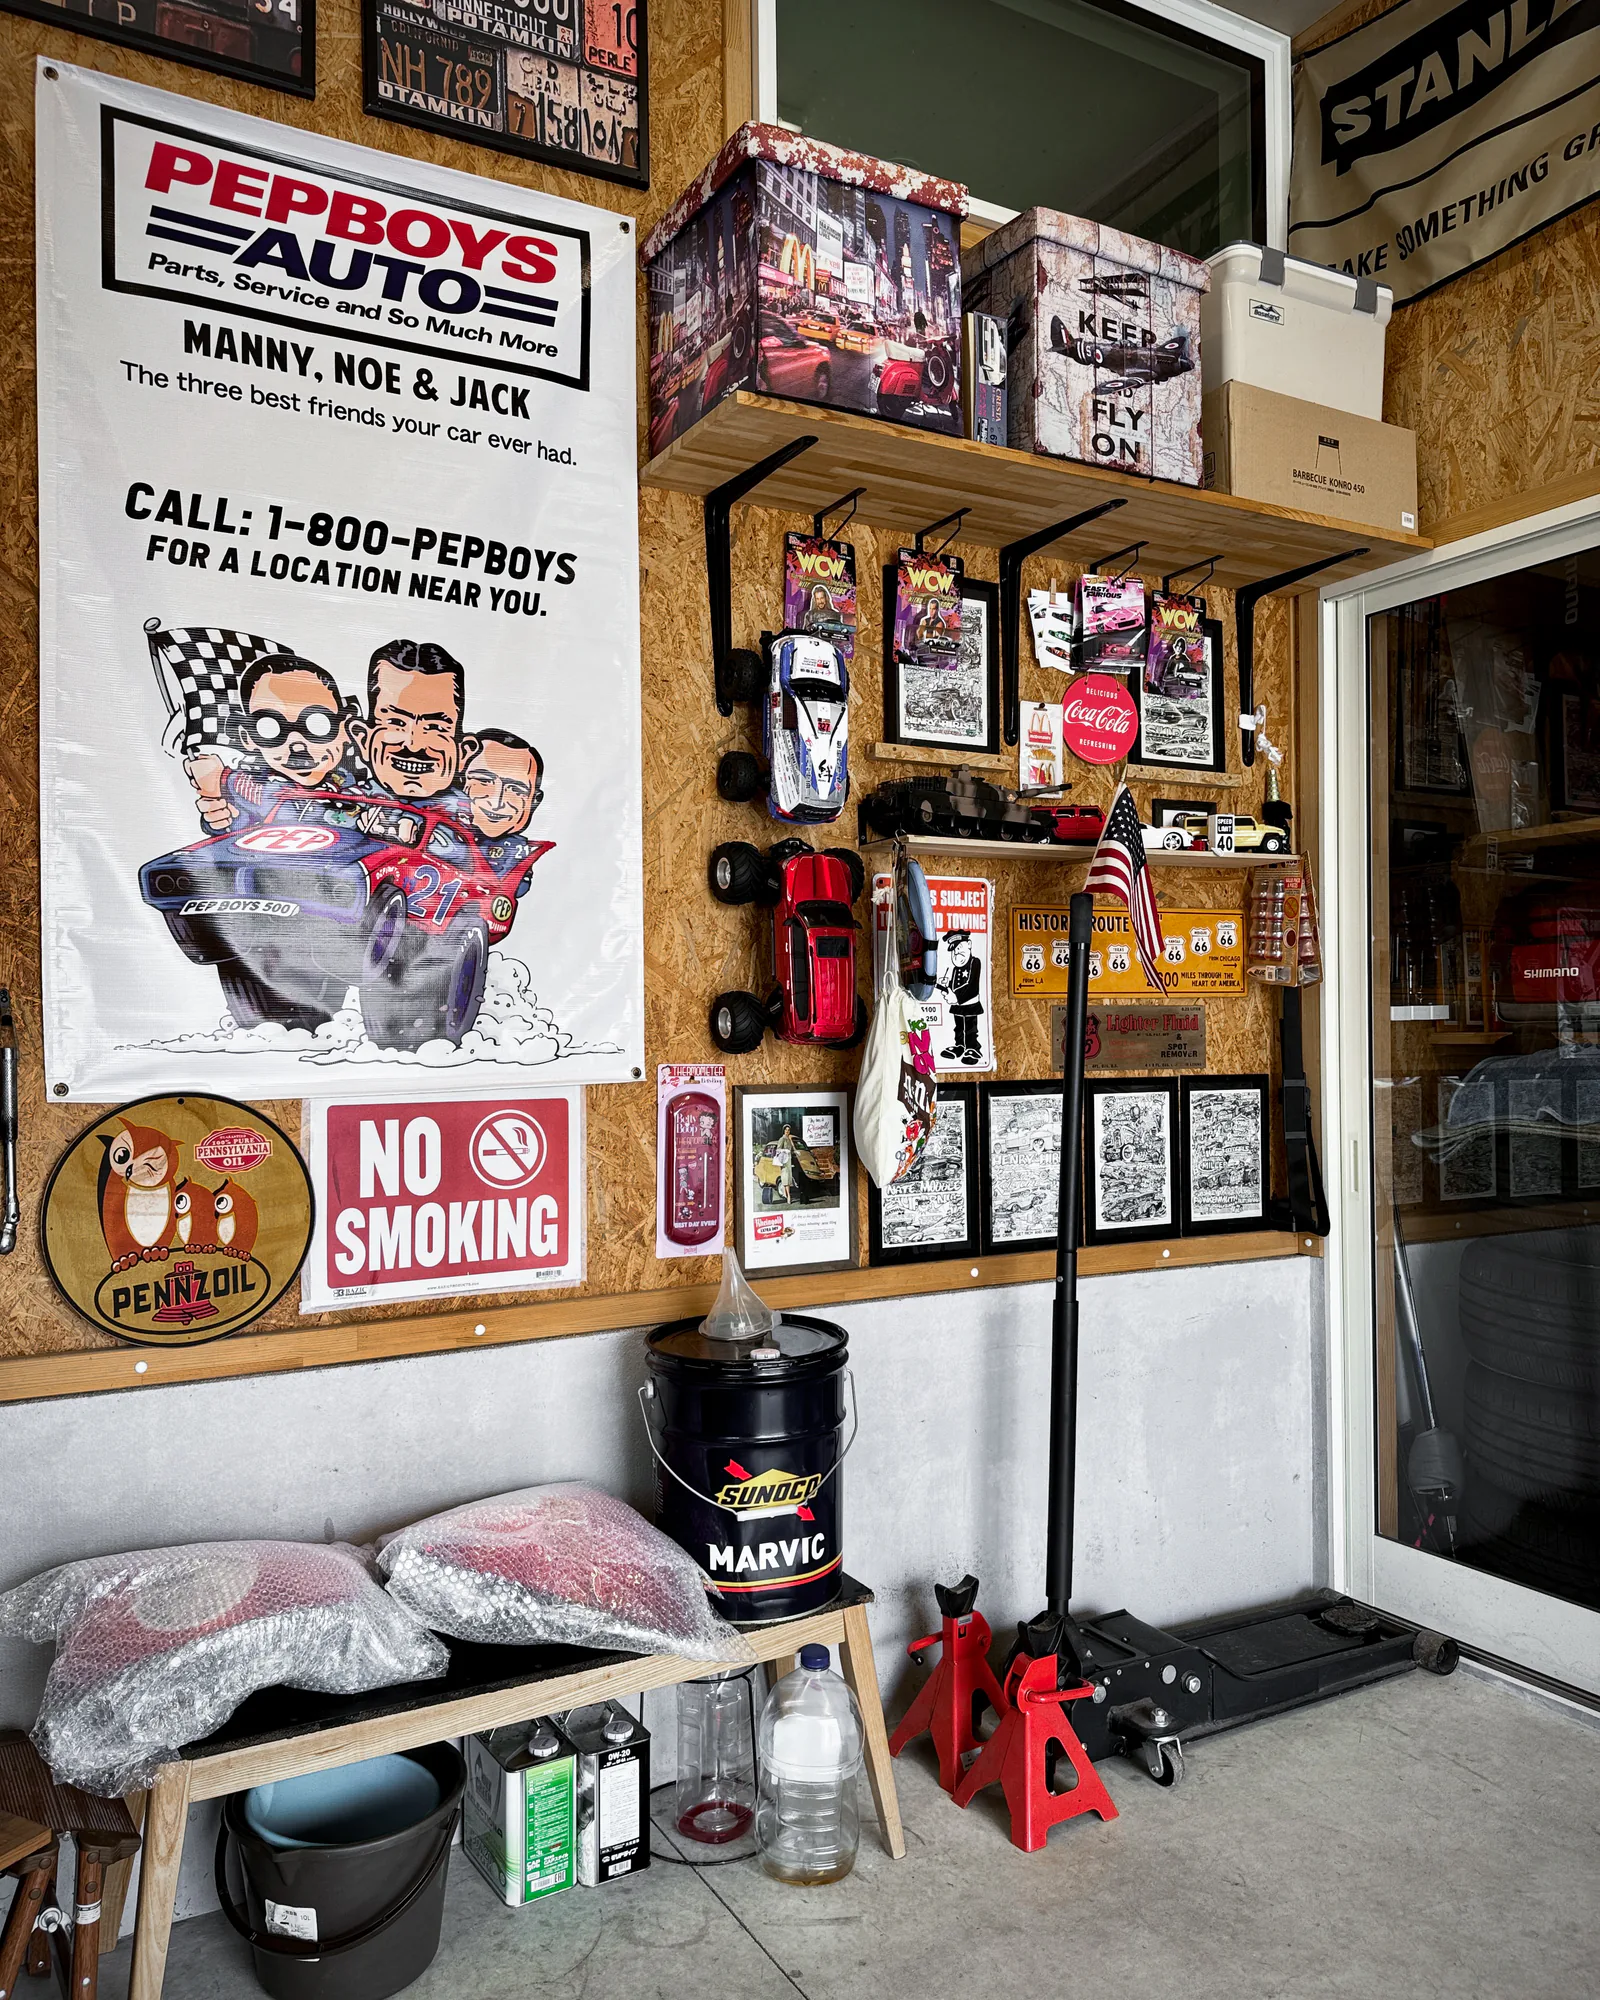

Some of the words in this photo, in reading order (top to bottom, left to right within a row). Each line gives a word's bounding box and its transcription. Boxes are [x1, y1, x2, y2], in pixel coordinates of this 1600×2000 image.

[447, 6, 573, 57] POTAMKIN
[588, 46, 633, 73] PERLE
[380, 37, 427, 94] NH
[435, 55, 493, 112] 789
[144, 141, 559, 284] PEPBOYS
[1327, 242, 1389, 278] AKE
[1395, 152, 1549, 261] SOMETHING
[233, 227, 481, 315] AUTO
[148, 252, 224, 288] Parts,
[233, 272, 330, 310] Service
[335, 298, 382, 326] and
[388, 308, 420, 328] So
[425, 316, 493, 344] Much
[499, 332, 560, 358] More
[184, 319, 323, 383] MANNY,
[334, 351, 402, 396] NOE
[412, 367, 439, 402] &
[450, 375, 531, 420] JACK
[120, 359, 169, 389] The
[177, 370, 244, 401] three
[250, 383, 301, 412] best
[307, 396, 386, 428] friends
[392, 415, 441, 443] your
[447, 425, 482, 445] car
[488, 432, 533, 454] ever
[537, 440, 578, 467] had.
[1092, 399, 1144, 431] FLY
[1091, 433, 1141, 463] ON
[1292, 468, 1327, 486] BARBECUE
[1329, 477, 1352, 492] KONRO
[1353, 484, 1365, 494] 450
[124, 482, 252, 536] CALL:
[267, 504, 579, 586] 1-800-PEPBOYS
[145, 534, 211, 570] FOR
[218, 547, 240, 573] A
[250, 552, 400, 595] LOCATION
[408, 573, 481, 608] NEAR
[489, 586, 548, 617] YOU.
[796, 550, 846, 580] WCW
[907, 566, 955, 593] WCW
[1159, 606, 1199, 631] WCW
[1086, 687, 1118, 700] DELICIOUS
[1079, 738, 1117, 751] REFRESHING
[252, 828, 334, 852] PEP
[1217, 835, 1233, 851] 40
[407, 864, 463, 926] 21
[940, 889, 985, 908] SUBJECT
[184, 901, 216, 913] PEP
[217, 901, 260, 914] BOYS
[263, 903, 290, 916] 500
[946, 913, 987, 930] TOWING
[1019, 913, 1069, 931] HISTOR
[1091, 916, 1130, 933] ROUTE
[1194, 942, 1208, 952] 66
[1220, 935, 1233, 945] 66
[1026, 959, 1041, 970] 66
[1112, 959, 1126, 969] 66
[1168, 951, 1182, 961] 66
[1523, 966, 1580, 980] SHIMANO
[1106, 1013, 1159, 1034] Lighter
[1162, 1013, 1199, 1031] Fluid
[1160, 1050, 1198, 1058] REMOVER
[672, 1065, 725, 1077] THERMOMETER
[676, 1124, 698, 1137] Boop
[197, 1143, 269, 1158] PENNSYLVANIA
[222, 1157, 245, 1167] OIL
[359, 1116, 442, 1199] NO
[334, 1194, 559, 1277] SMOKING
[112, 1264, 257, 1318] PENNZOIL
[345, 1286, 368, 1295] BAZIC
[719, 1475, 818, 1506] SUNOCO
[705, 1532, 826, 1574] MARVIC
[608, 1748, 631, 1761] 0W-20
